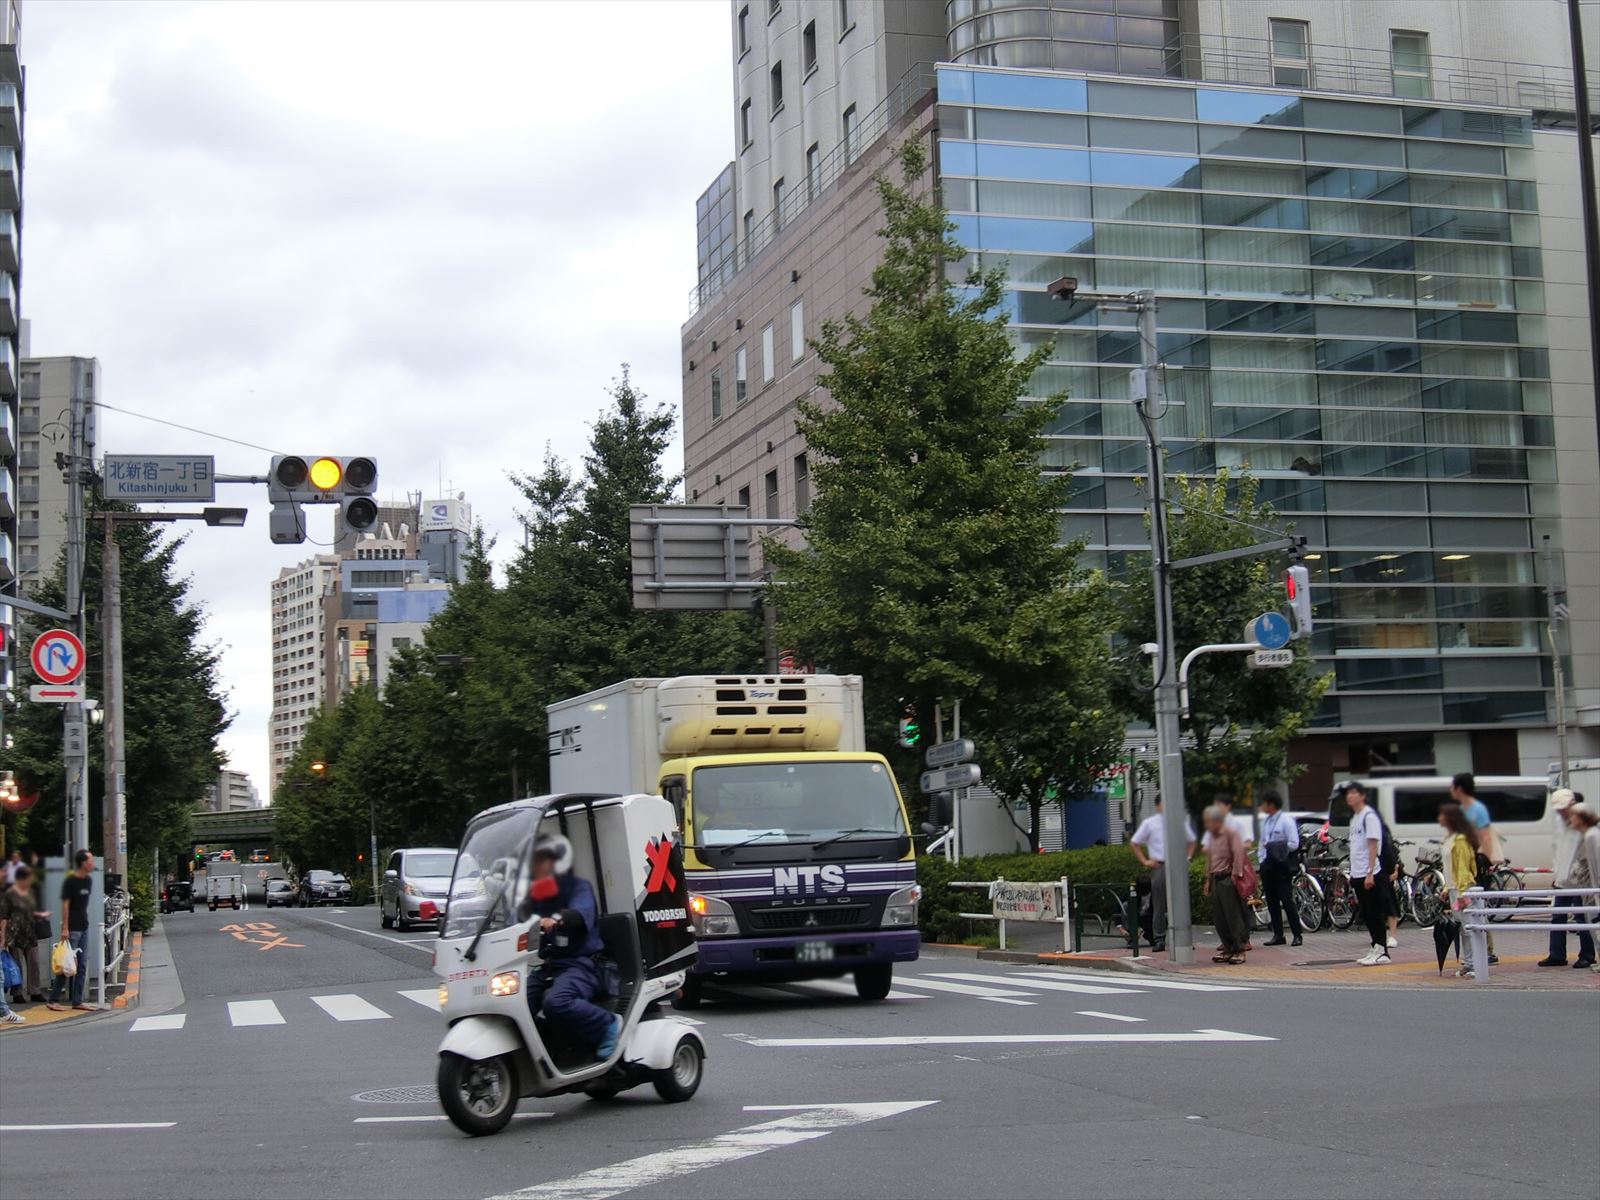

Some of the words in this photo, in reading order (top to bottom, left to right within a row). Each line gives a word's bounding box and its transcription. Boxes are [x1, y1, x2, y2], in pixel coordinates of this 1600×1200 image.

[110, 460, 208, 480] 北新宿一丁目
[118, 482, 188, 494] Kitashinjuku
[192, 482, 198, 493] 1
[774, 864, 845, 895] NTS
[771, 897, 851, 906] FUSO
[643, 907, 687, 922] YODOBASHI
